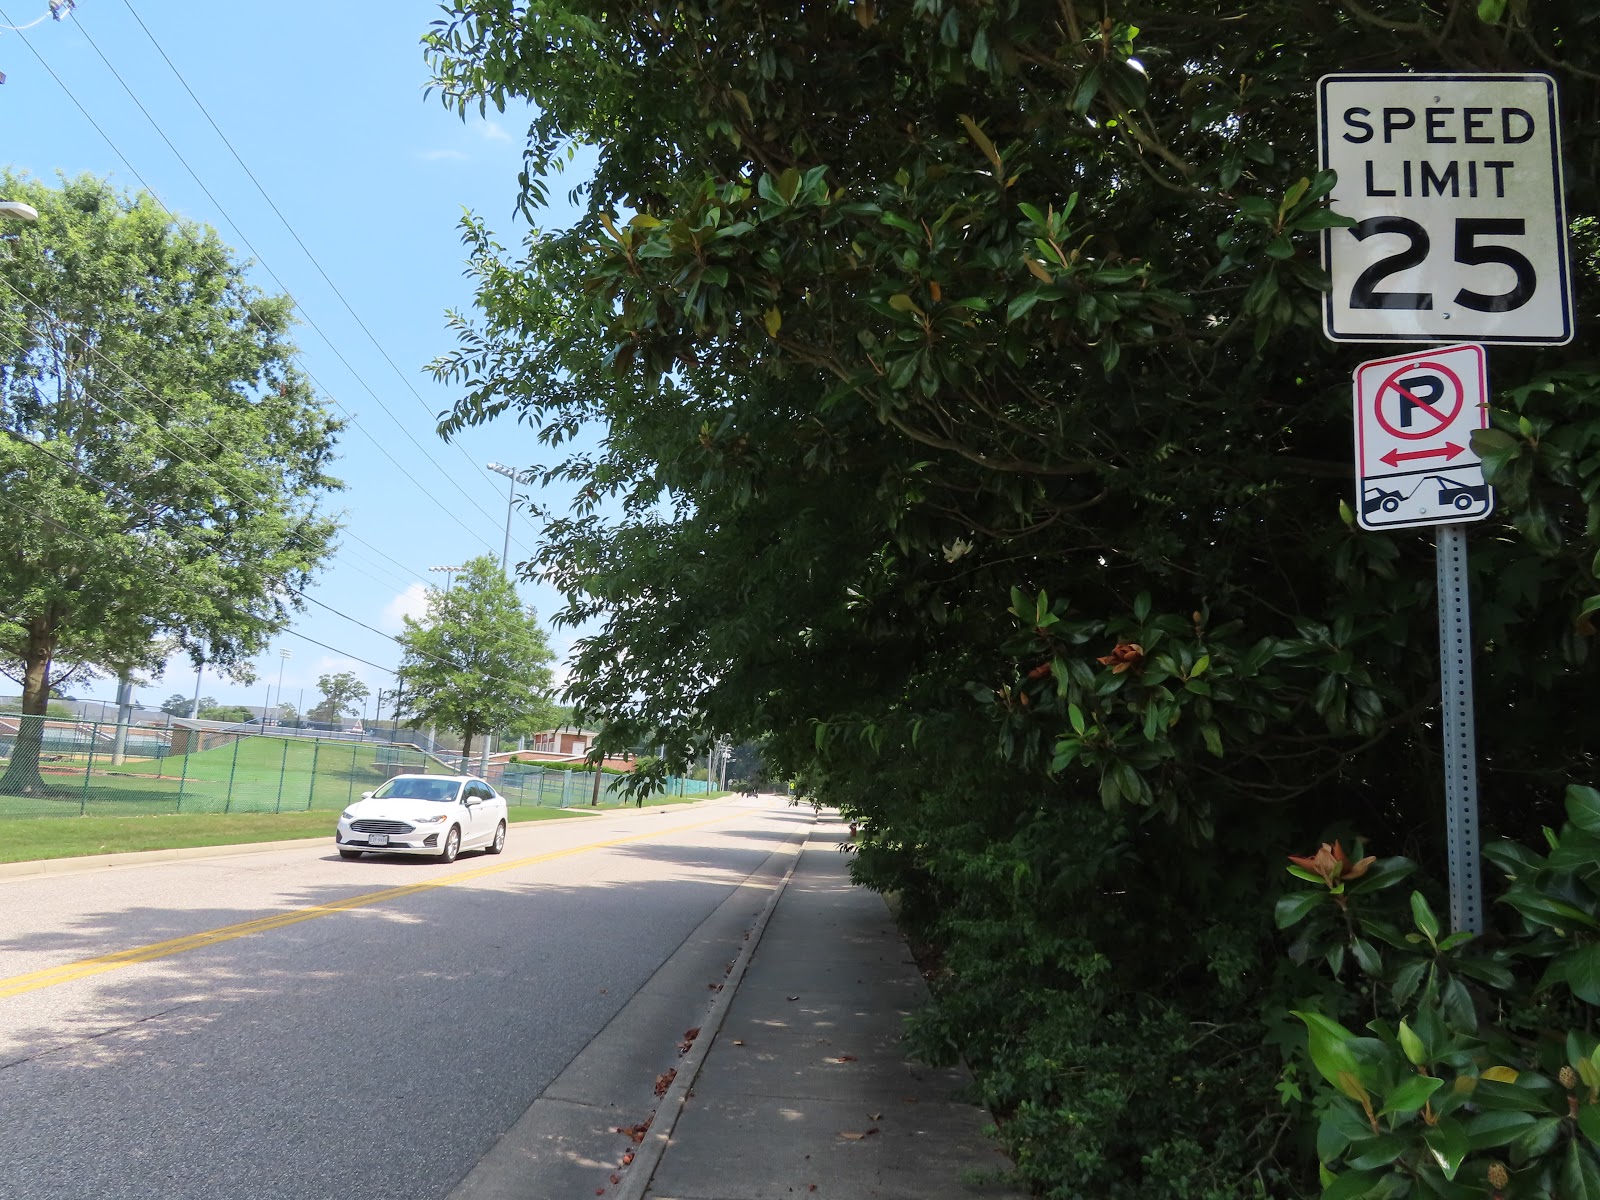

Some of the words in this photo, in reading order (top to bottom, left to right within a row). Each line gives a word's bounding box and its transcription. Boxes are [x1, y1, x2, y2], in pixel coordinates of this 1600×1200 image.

[1343, 107, 1535, 144] SPEED
[1365, 160, 1514, 198] LIMIT
[1347, 216, 1537, 313] 25
[1399, 375, 1445, 428] P
